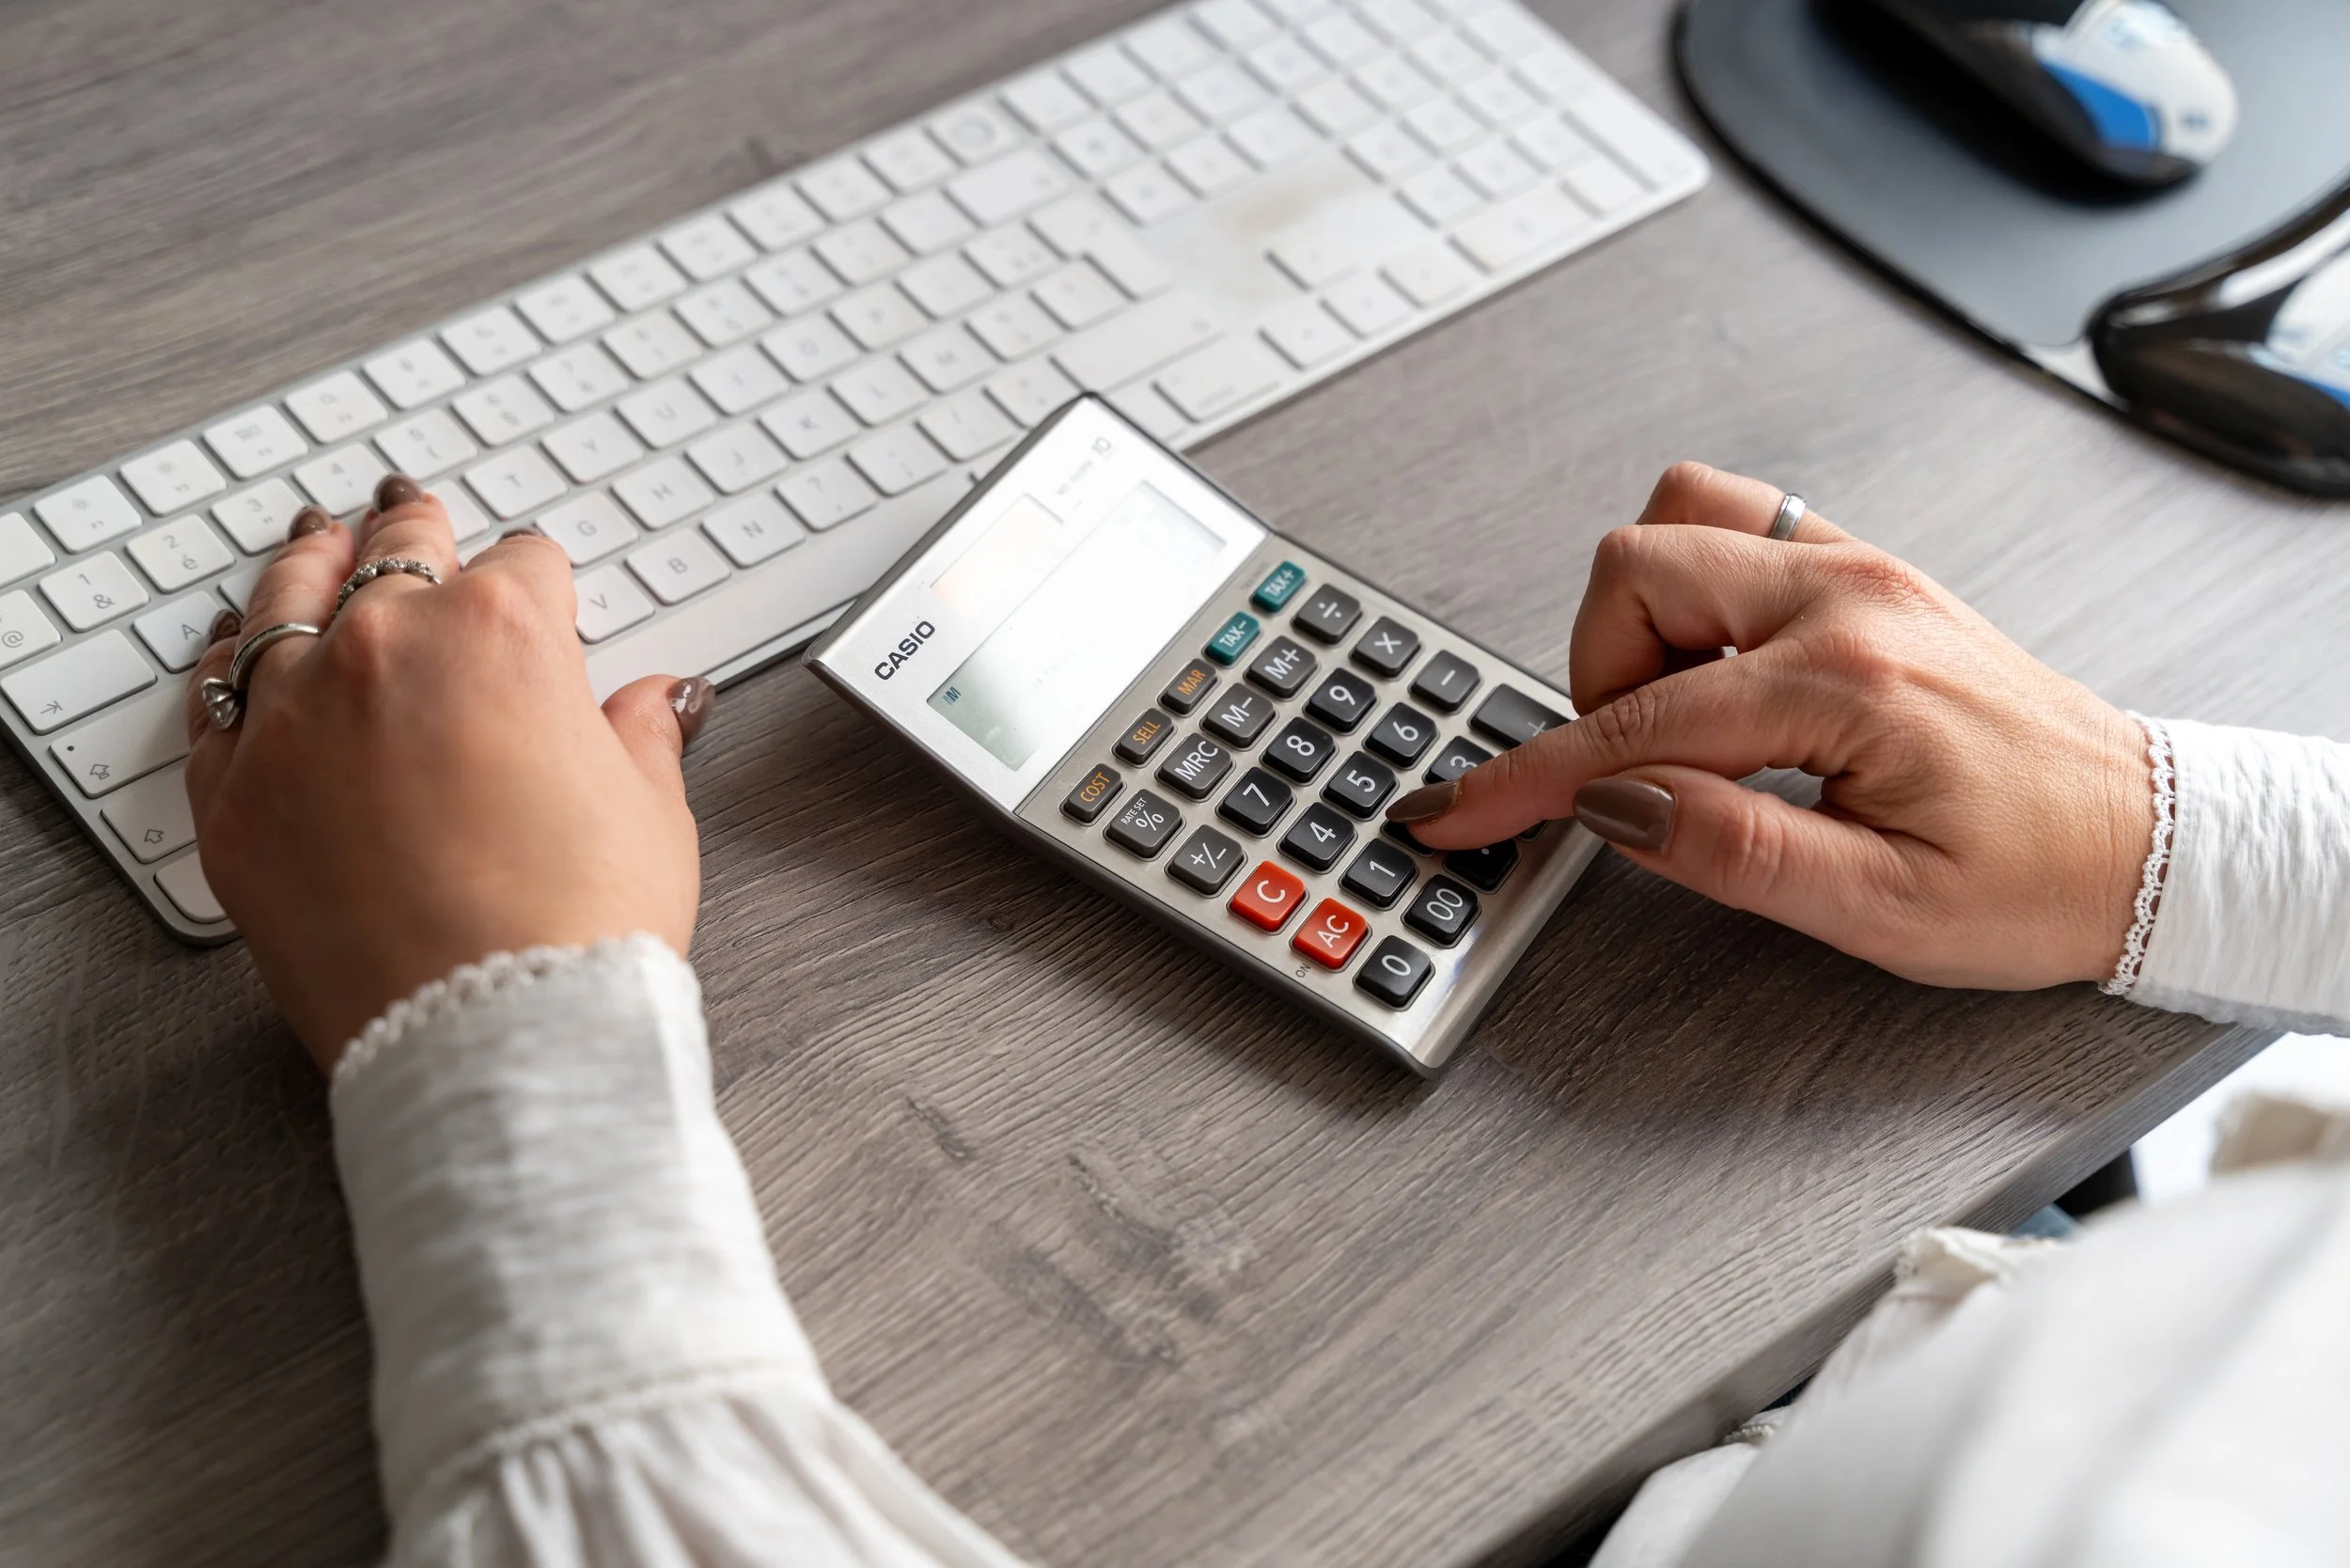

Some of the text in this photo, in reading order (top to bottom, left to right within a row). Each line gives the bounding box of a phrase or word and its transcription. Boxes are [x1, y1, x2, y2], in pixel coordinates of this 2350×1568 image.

[654, 403, 677, 422] U
[579, 438, 599, 456] Y
[504, 473, 522, 490] T
[650, 482, 675, 502] H
[246, 497, 264, 513] 3
[575, 520, 597, 537] G
[741, 520, 765, 539] N
[163, 533, 181, 550] 2
[666, 557, 688, 575] B
[77, 572, 91, 587] 1
[1264, 570, 1294, 595] TAX+
[92, 593, 116, 610] &
[588, 593, 608, 611] V
[2, 630, 24, 649] @
[181, 623, 201, 640] A
[874, 620, 936, 681] CASIO
[1264, 649, 1300, 680] M+
[1177, 669, 1206, 696] MAR
[1329, 685, 1355, 706] 9
[1221, 697, 1253, 728] M-
[1132, 721, 1162, 745] SELL
[1392, 721, 1419, 742] 6
[1286, 735, 1315, 757] 8
[1174, 741, 1218, 781] MRC
[1080, 772, 1110, 803] COST
[1346, 769, 1376, 792] 5
[1242, 782, 1270, 807] 7
[1120, 797, 1148, 825] RATE SET
[1135, 809, 1165, 831] %
[1309, 821, 1337, 843] 4
[1369, 859, 1397, 878] 1
[1256, 880, 1286, 903] C
[1426, 887, 1464, 921] 00
[1316, 915, 1350, 949] AC
[1295, 963, 1312, 979] ON
[1381, 954, 1412, 977] 0
